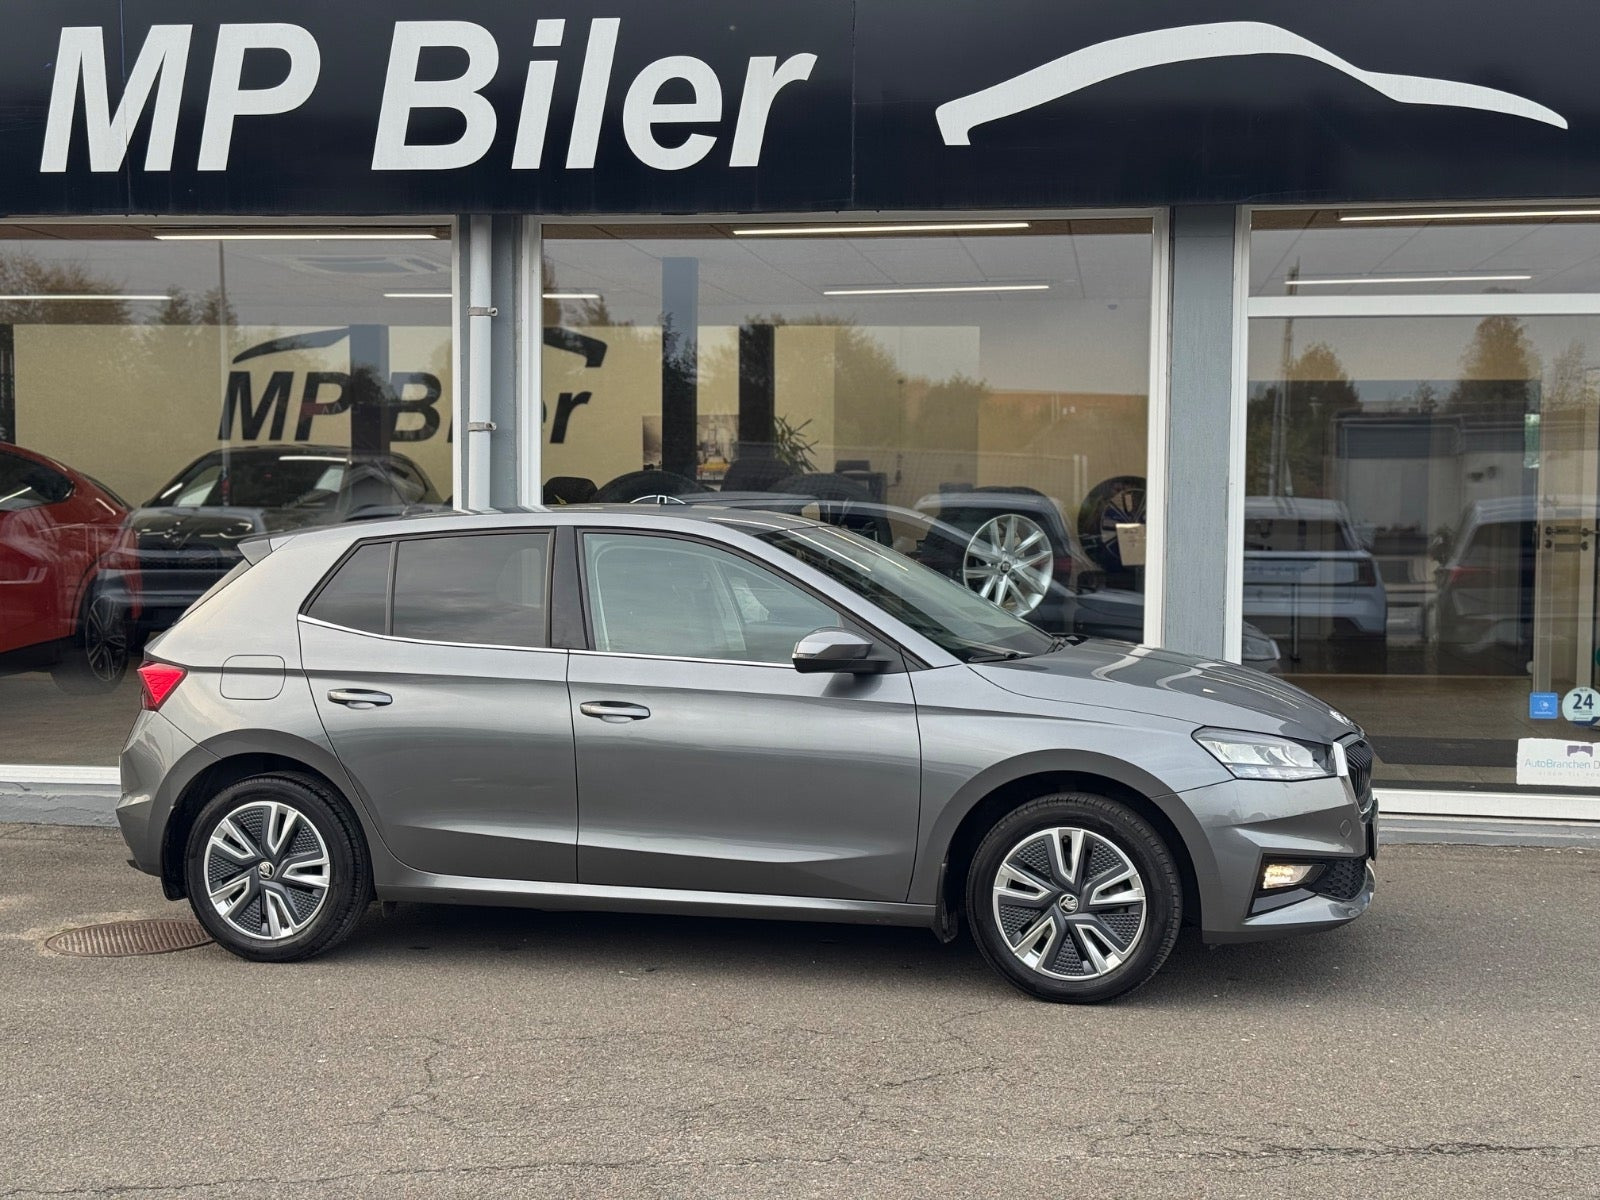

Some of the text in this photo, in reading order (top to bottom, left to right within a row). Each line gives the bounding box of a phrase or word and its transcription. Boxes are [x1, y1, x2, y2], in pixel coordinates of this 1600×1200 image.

[40, 18, 817, 172] MP Biler
[217, 371, 353, 442] MP
[1573, 693, 1594, 710] 24
[1524, 757, 1591, 769] AutoBranchen
